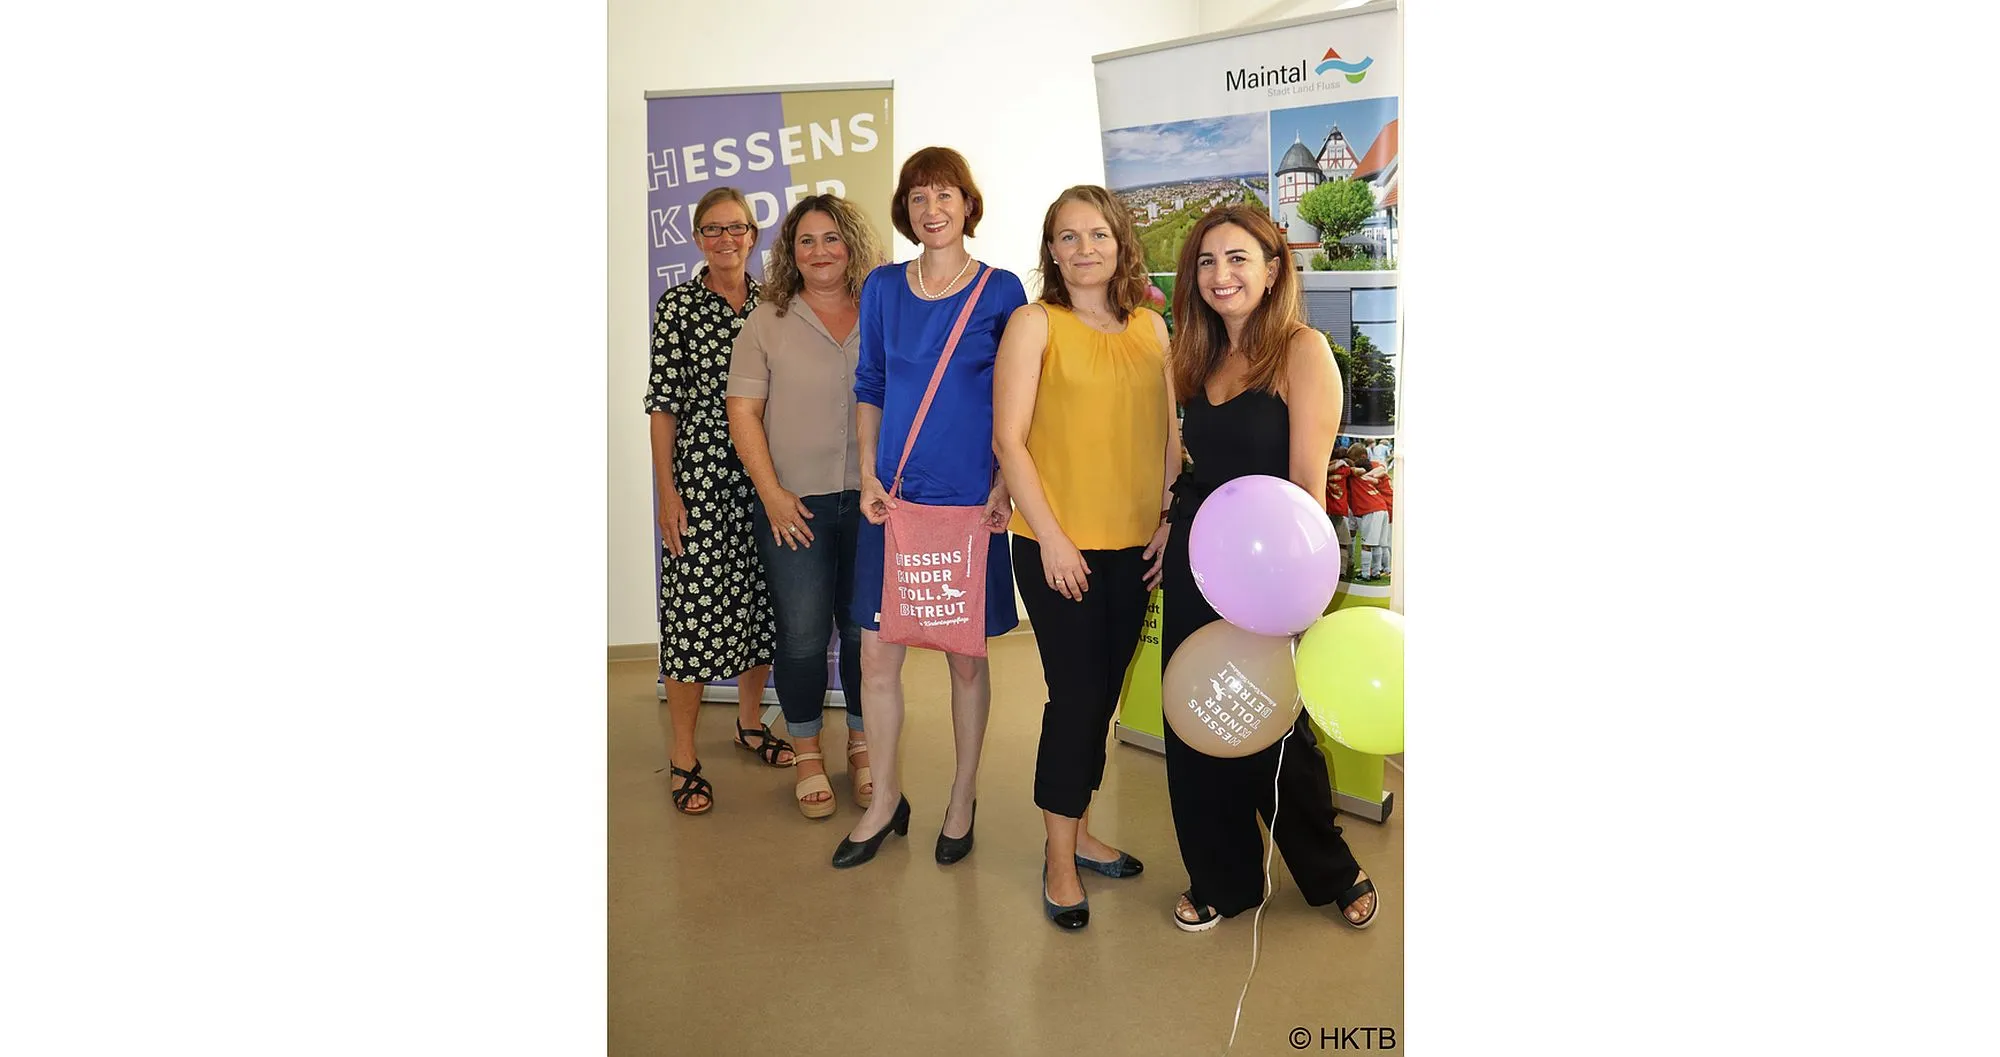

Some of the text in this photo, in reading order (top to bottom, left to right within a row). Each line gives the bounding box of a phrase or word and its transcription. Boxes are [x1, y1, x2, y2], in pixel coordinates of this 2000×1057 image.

[1226, 59, 1307, 91] Maintal
[1267, 80, 1341, 97] Stadt Land Fluss
[647, 112, 879, 191] HESSENS
[895, 551, 961, 567] HESSENS
[897, 569, 952, 584] KINDER
[900, 602, 966, 618] BETREUT
[1217, 669, 1273, 718] BETREUT
[1187, 699, 1242, 746] HESSENS
[1204, 697, 1252, 739] KINDER
